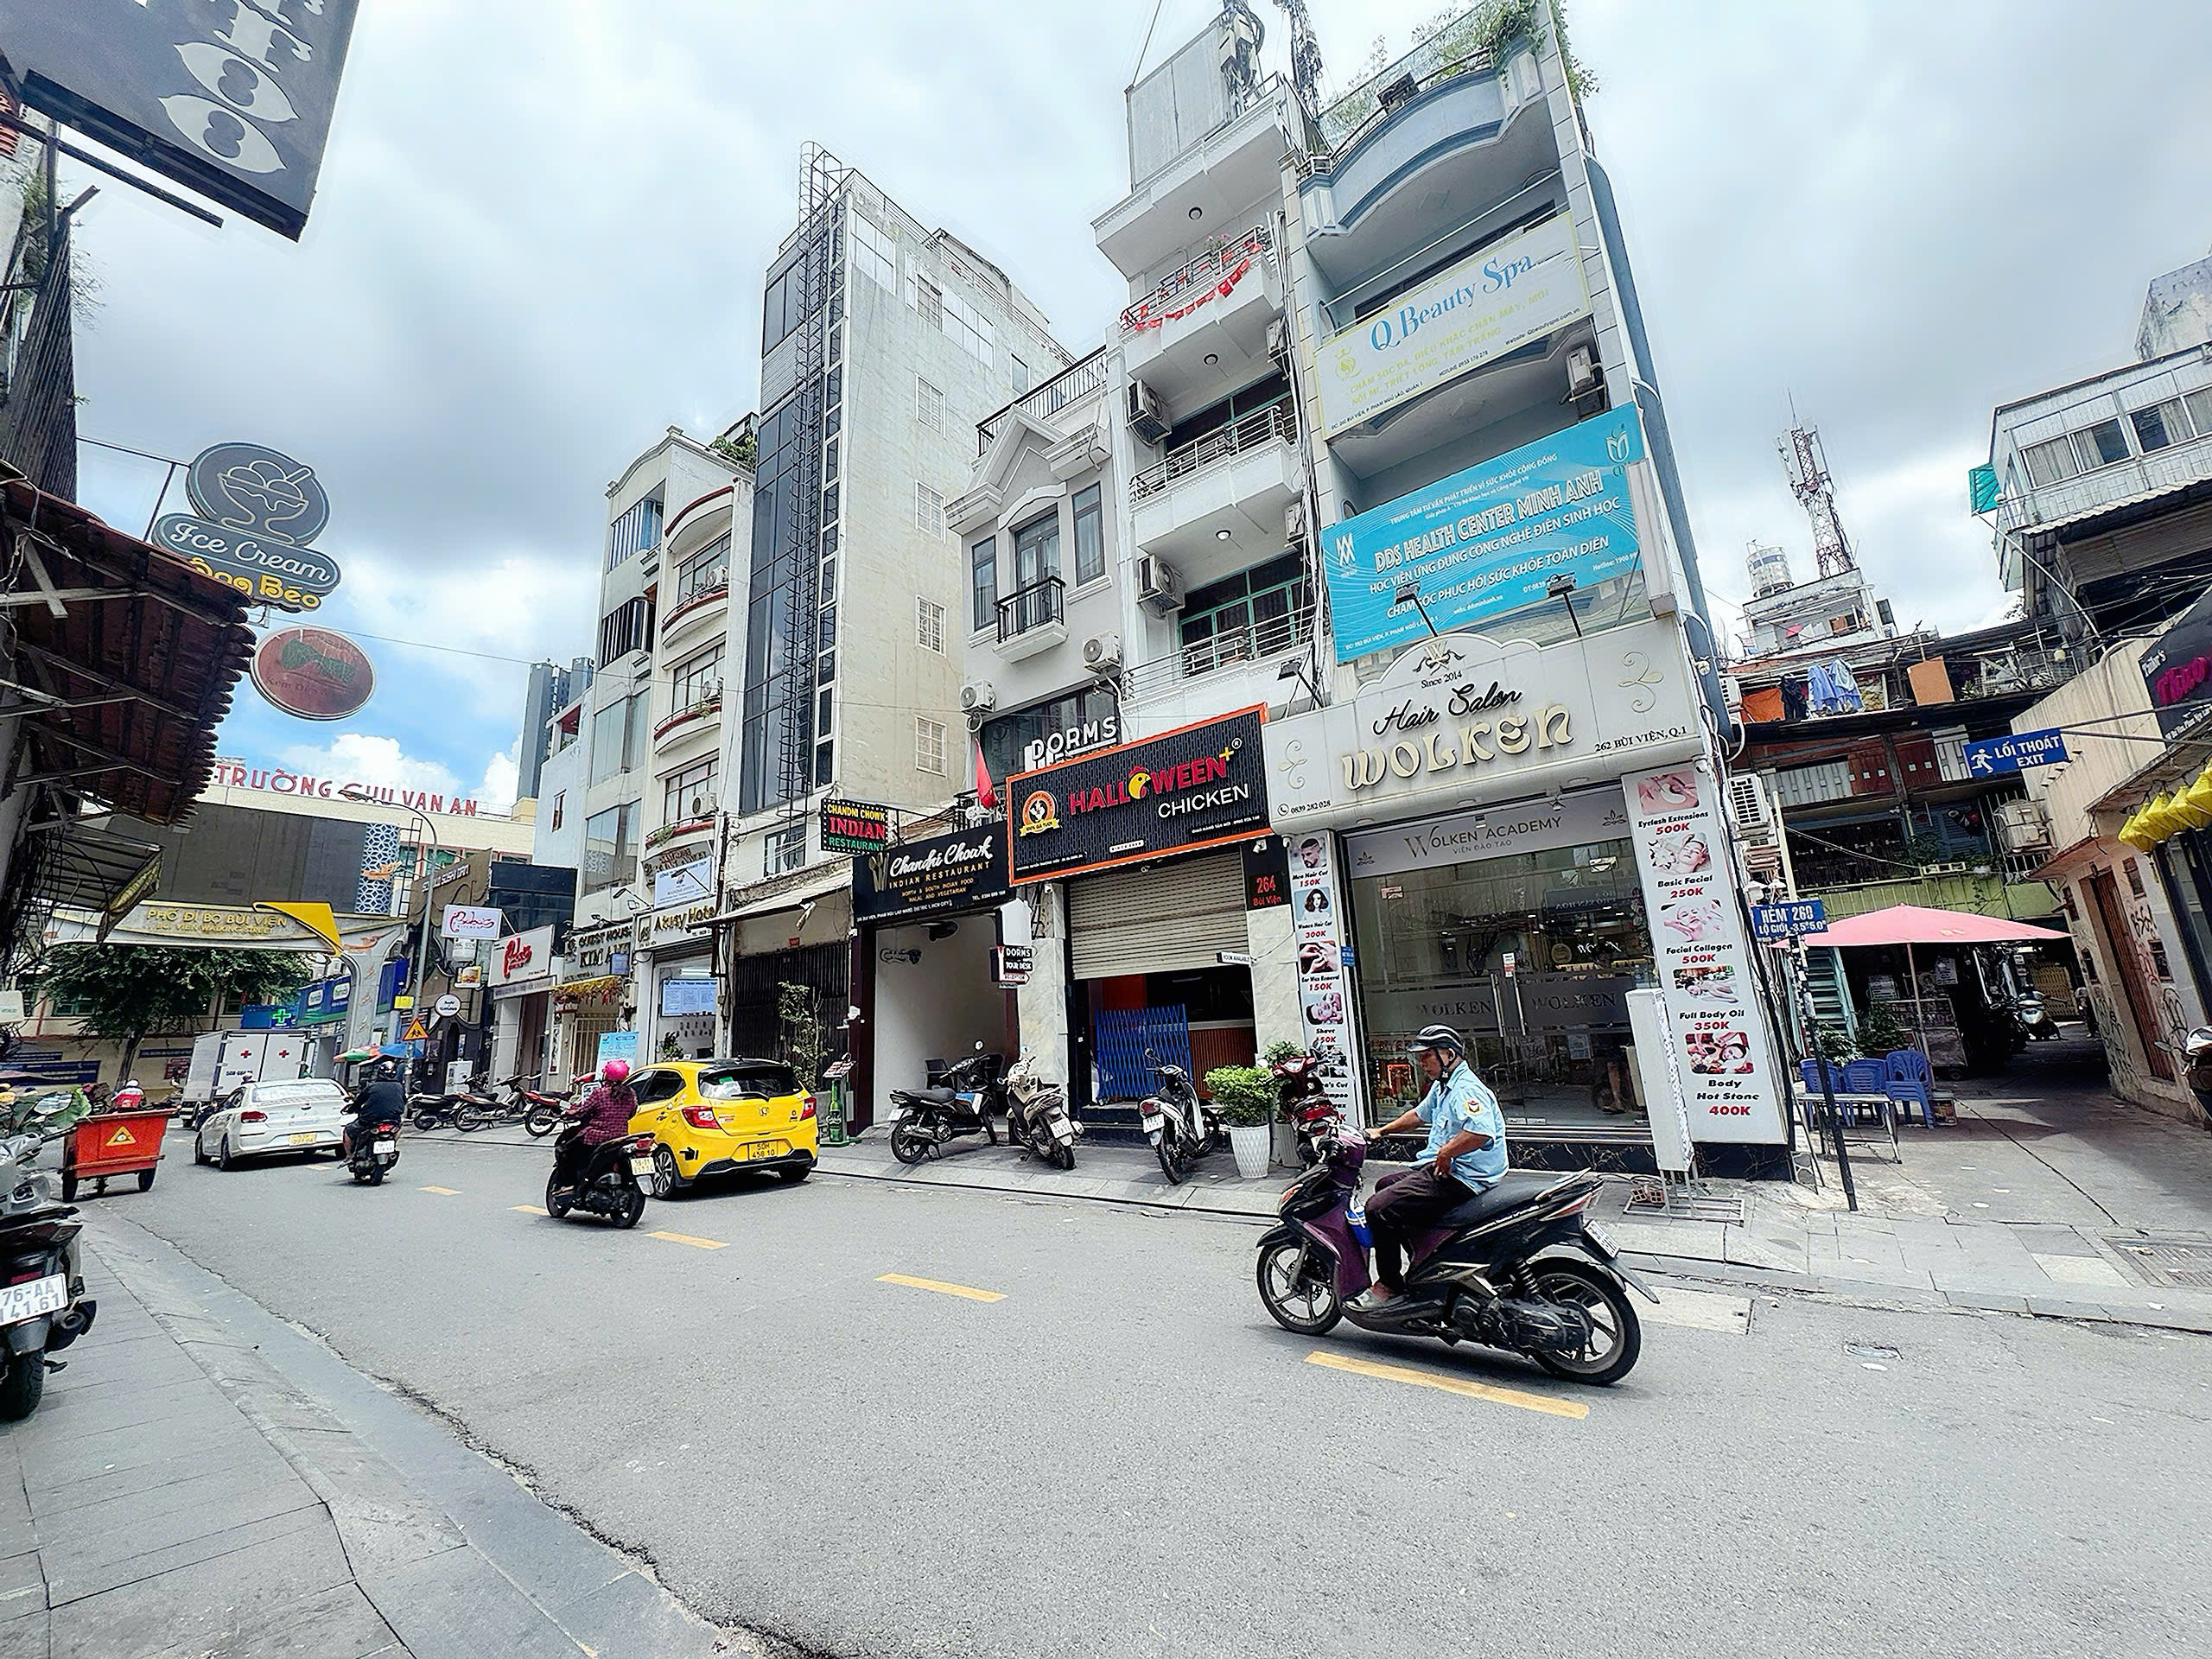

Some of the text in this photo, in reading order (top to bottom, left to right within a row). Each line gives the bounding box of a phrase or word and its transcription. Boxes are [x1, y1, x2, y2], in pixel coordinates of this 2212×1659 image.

[1370, 255, 1534, 351] Q Beauty Spa
[1374, 468, 1605, 575] DDS HEALTH CENTER MINH ANH
[1414, 559, 1438, 579] ỨNG
[1469, 536, 1502, 559] CÔNG
[1501, 527, 1535, 551] NGHỆ
[1534, 517, 1561, 537] ĐIỆN
[1563, 506, 1593, 526] SINH
[1593, 496, 1621, 518] HỌC
[171, 522, 331, 582] Ice Cream
[1438, 582, 1467, 604] PHỤC
[1488, 564, 1511, 587] SỨC
[1512, 555, 1544, 575] KHỎE
[1545, 543, 1579, 566] TOÀN
[1580, 534, 1610, 556] DIỆN
[259, 574, 321, 608] Béo
[1421, 671, 1464, 689] Since 2014
[1372, 681, 1522, 736] Hair Salon
[1031, 715, 1116, 761] DORMS
[1595, 742, 1612, 753] 262
[1614, 735, 1633, 748] BÙI
[1994, 734, 2061, 759] LỐI THOÁT
[2016, 753, 2045, 767] EXIT
[216, 764, 333, 798] TRƯỜNG
[449, 797, 478, 817] AN
[1158, 783, 1250, 818] CHICKEN
[827, 804, 886, 822] CHANDNI CHOWK
[1638, 810, 1709, 829] Eyelash Extensions
[830, 817, 886, 840] INDIAN
[1404, 816, 1562, 857] WOLKEN ACADEMY
[1656, 823, 1691, 836] 500K
[829, 836, 885, 851] RESTAURANT
[944, 835, 994, 864] Chowk
[889, 861, 989, 889] INDIAN RESTAURANT
[1256, 874, 1277, 894] 264
[1300, 879, 1321, 887] 150K
[1657, 874, 1713, 888] Basic Facial
[1253, 895, 1265, 906] Bùi
[1669, 887, 1705, 899] 250K
[146, 908, 287, 928] PHỐ ĐI BỘ BÙI VIỆN
[1760, 905, 1815, 924] HẺM 260
[1305, 930, 1326, 938] 300K
[1758, 923, 1770, 936] LỘ
[1006, 948, 1031, 957] DORMS
[1666, 943, 1733, 955] Facial Collagen
[1681, 954, 1716, 964] 500K
[1309, 982, 1332, 991] 150K
[1679, 1009, 1745, 1020] Full Body Oil
[1694, 1020, 1730, 1031] 350K
[1707, 1078, 1743, 1089] Body
[1722, 1092, 1761, 1101] Stone
[1709, 1105, 1752, 1116] 400K
